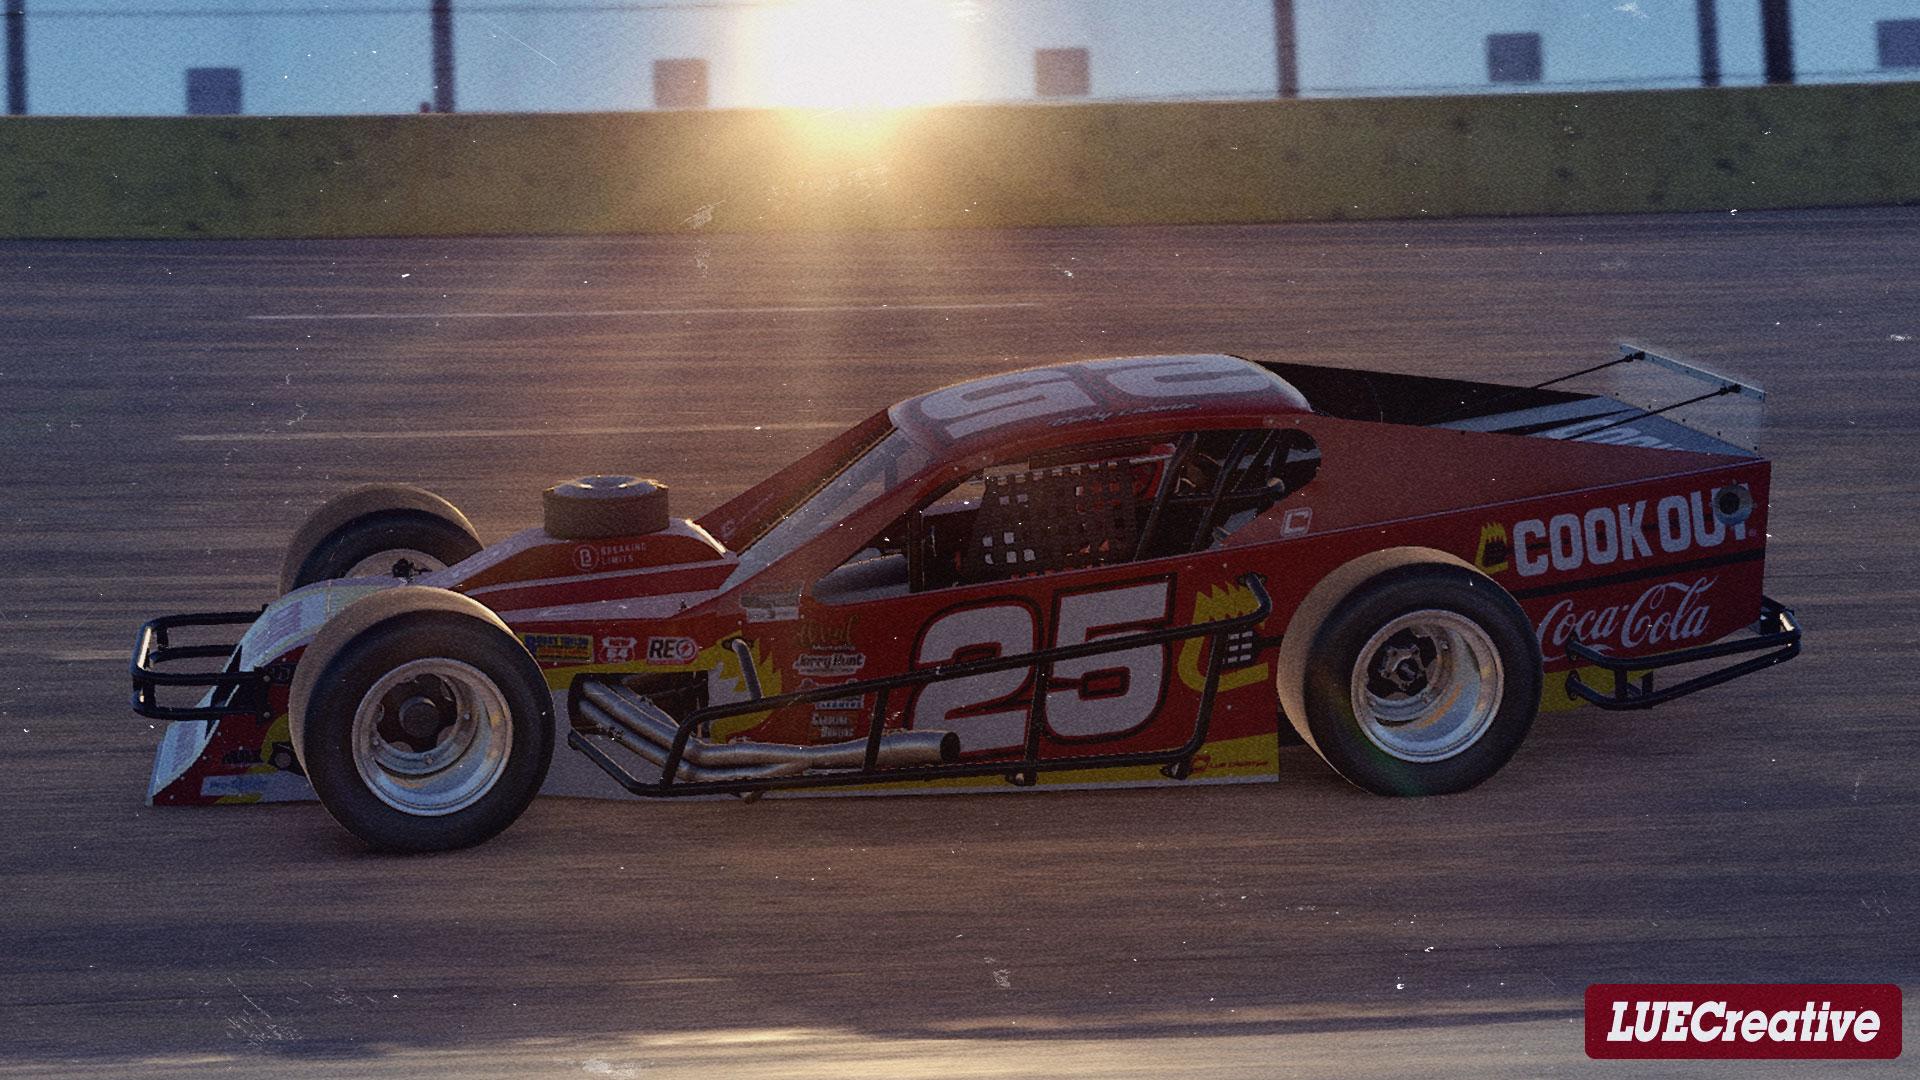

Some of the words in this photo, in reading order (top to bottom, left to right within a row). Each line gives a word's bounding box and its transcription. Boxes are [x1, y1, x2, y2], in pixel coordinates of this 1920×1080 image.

[600, 542, 646, 555] BREAKING
[601, 554, 634, 564] LIMITS
[1513, 501, 1653, 577] COOK
[1536, 576, 1718, 656] Coca-Cola
[910, 576, 1174, 757] 25
